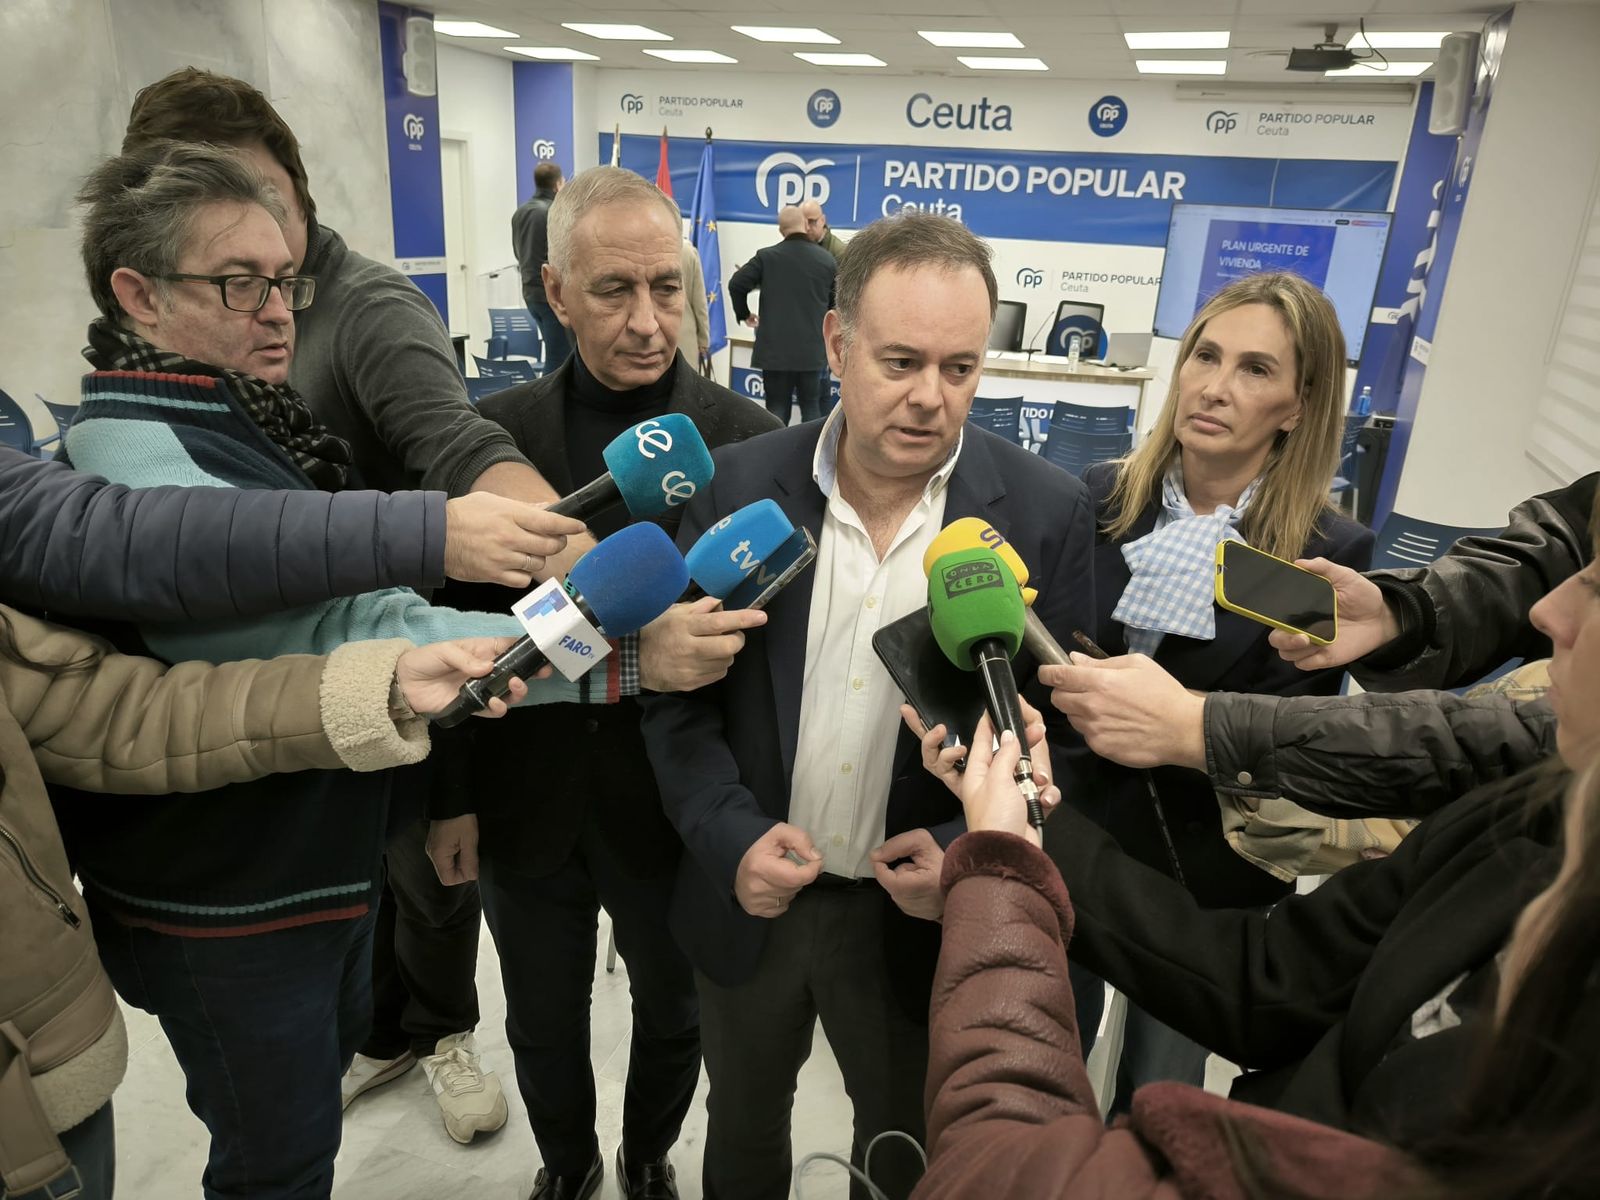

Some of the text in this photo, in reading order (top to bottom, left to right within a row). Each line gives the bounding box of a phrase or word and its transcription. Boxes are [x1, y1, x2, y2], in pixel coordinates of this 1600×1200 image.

[659, 96, 743, 108] PARTIDO POPULAR
[659, 107, 683, 116] Ceuta
[906, 93, 1012, 131] Ceuta
[1259, 112, 1375, 125] PARTIDO POPULAR
[1257, 125, 1289, 136] Ceuta
[884, 160, 1186, 200] PARTIDO POPULAR
[1222, 240, 1310, 256] PLAN URGENTE DE
[1219, 256, 1262, 269] VIVIENDA
[1062, 271, 1108, 283] PARTIDO
[1060, 282, 1089, 293] Ceuta
[950, 562, 992, 577] ONDA
[955, 574, 994, 589] CERO
[558, 635, 592, 656] FARO
